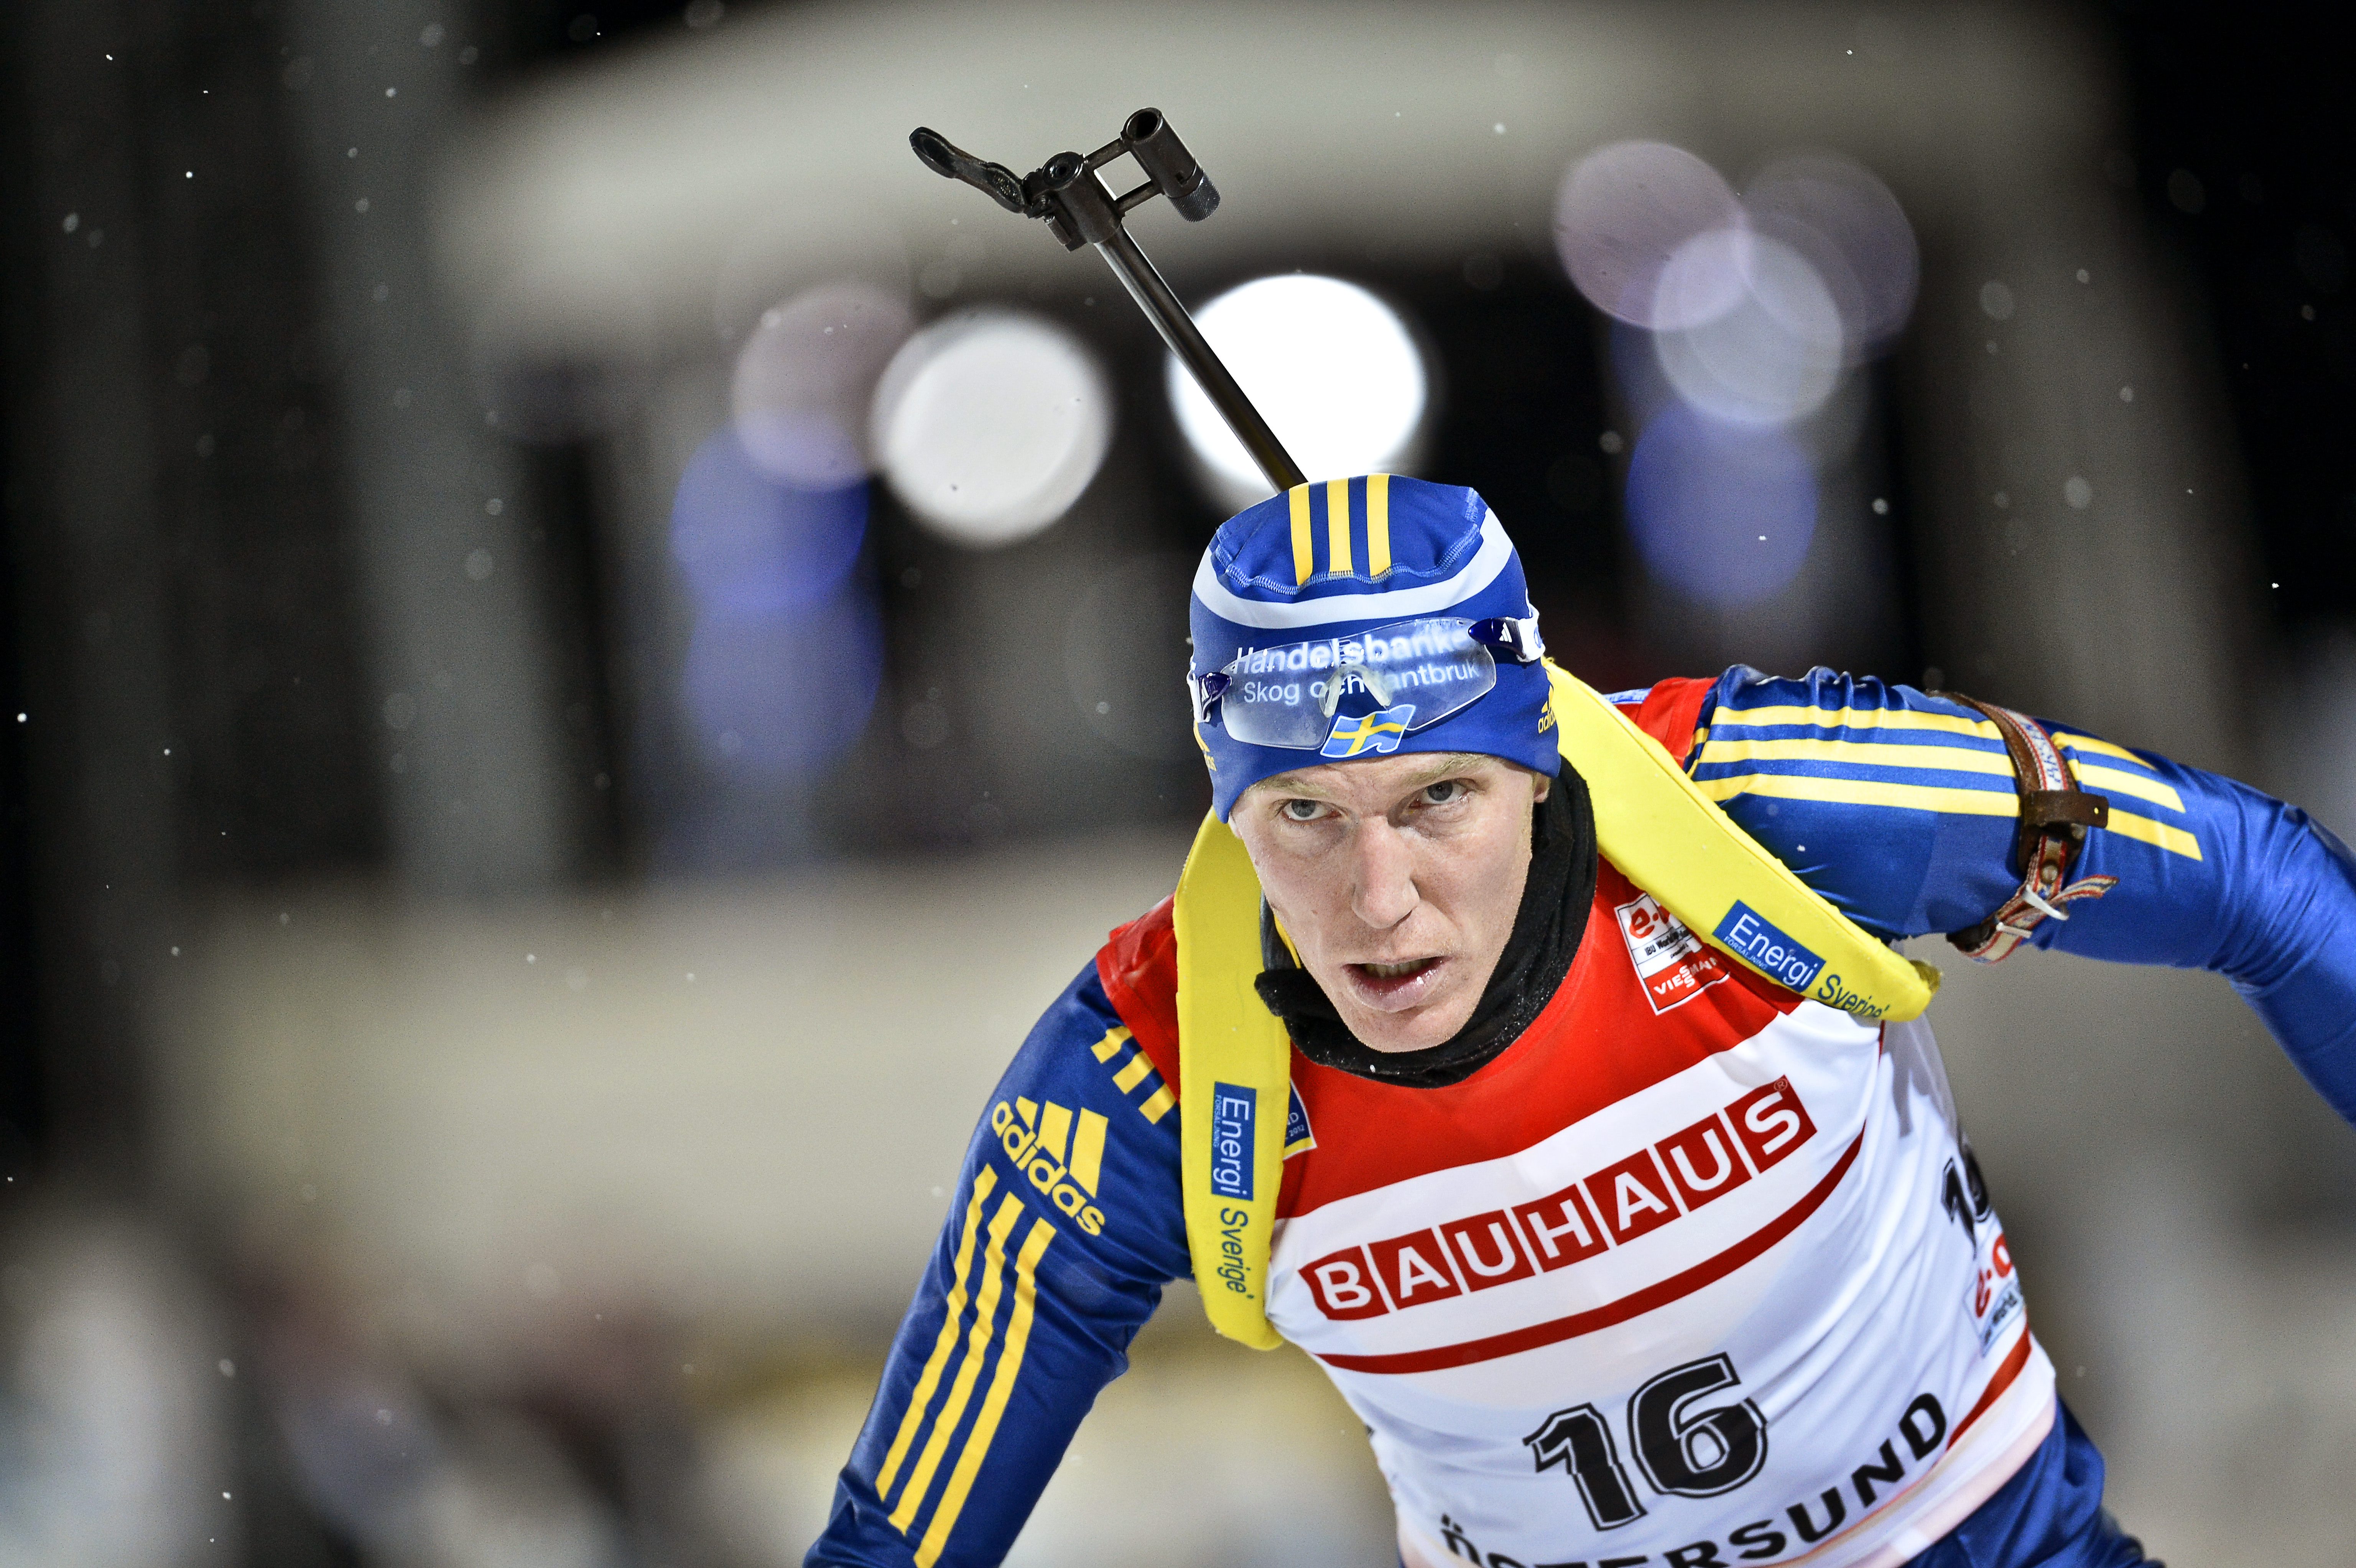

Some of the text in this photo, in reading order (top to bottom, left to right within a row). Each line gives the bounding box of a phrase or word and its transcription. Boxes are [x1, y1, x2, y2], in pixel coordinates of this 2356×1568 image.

[1243, 681, 1300, 705] Skog
[1380, 659, 1480, 691] antbruk
[1729, 913, 1818, 987] Energi
[992, 1101, 1105, 1236] adidas
[1213, 1096, 1250, 1196] Energi
[1315, 1092, 1801, 1310] BAUHAUS
[1441, 1393, 1947, 1568] ÖRSUND
[1522, 1352, 1769, 1532] 16
